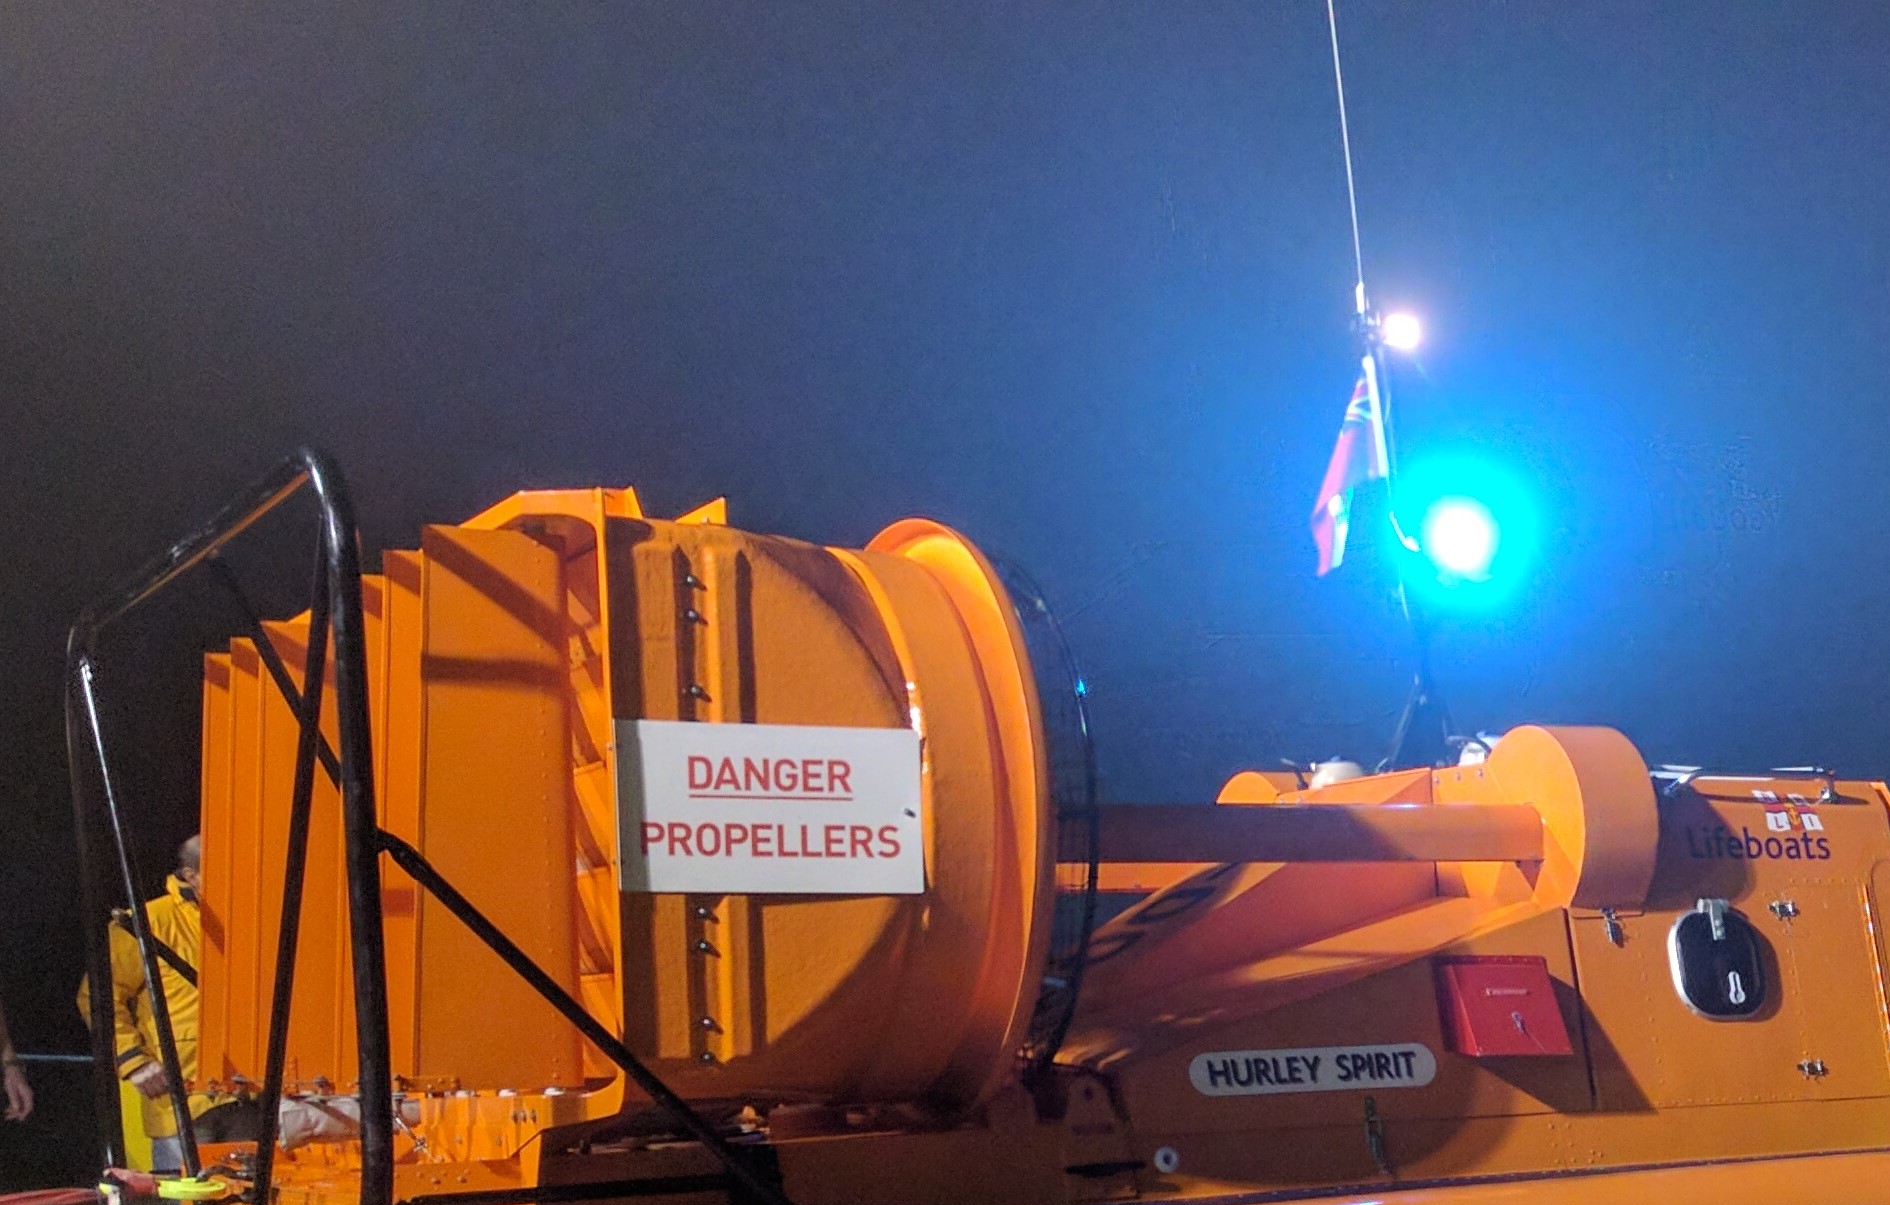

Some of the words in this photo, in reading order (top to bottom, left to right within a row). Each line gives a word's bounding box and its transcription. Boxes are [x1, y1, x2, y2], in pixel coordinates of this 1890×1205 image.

[688, 755, 852, 793] DANGER
[640, 822, 901, 858] PROPELLERS
[1687, 826, 1831, 860] Lifeboats
[1206, 1055, 1320, 1087] HURLEY
[1335, 1051, 1416, 1082] SPIRIT
